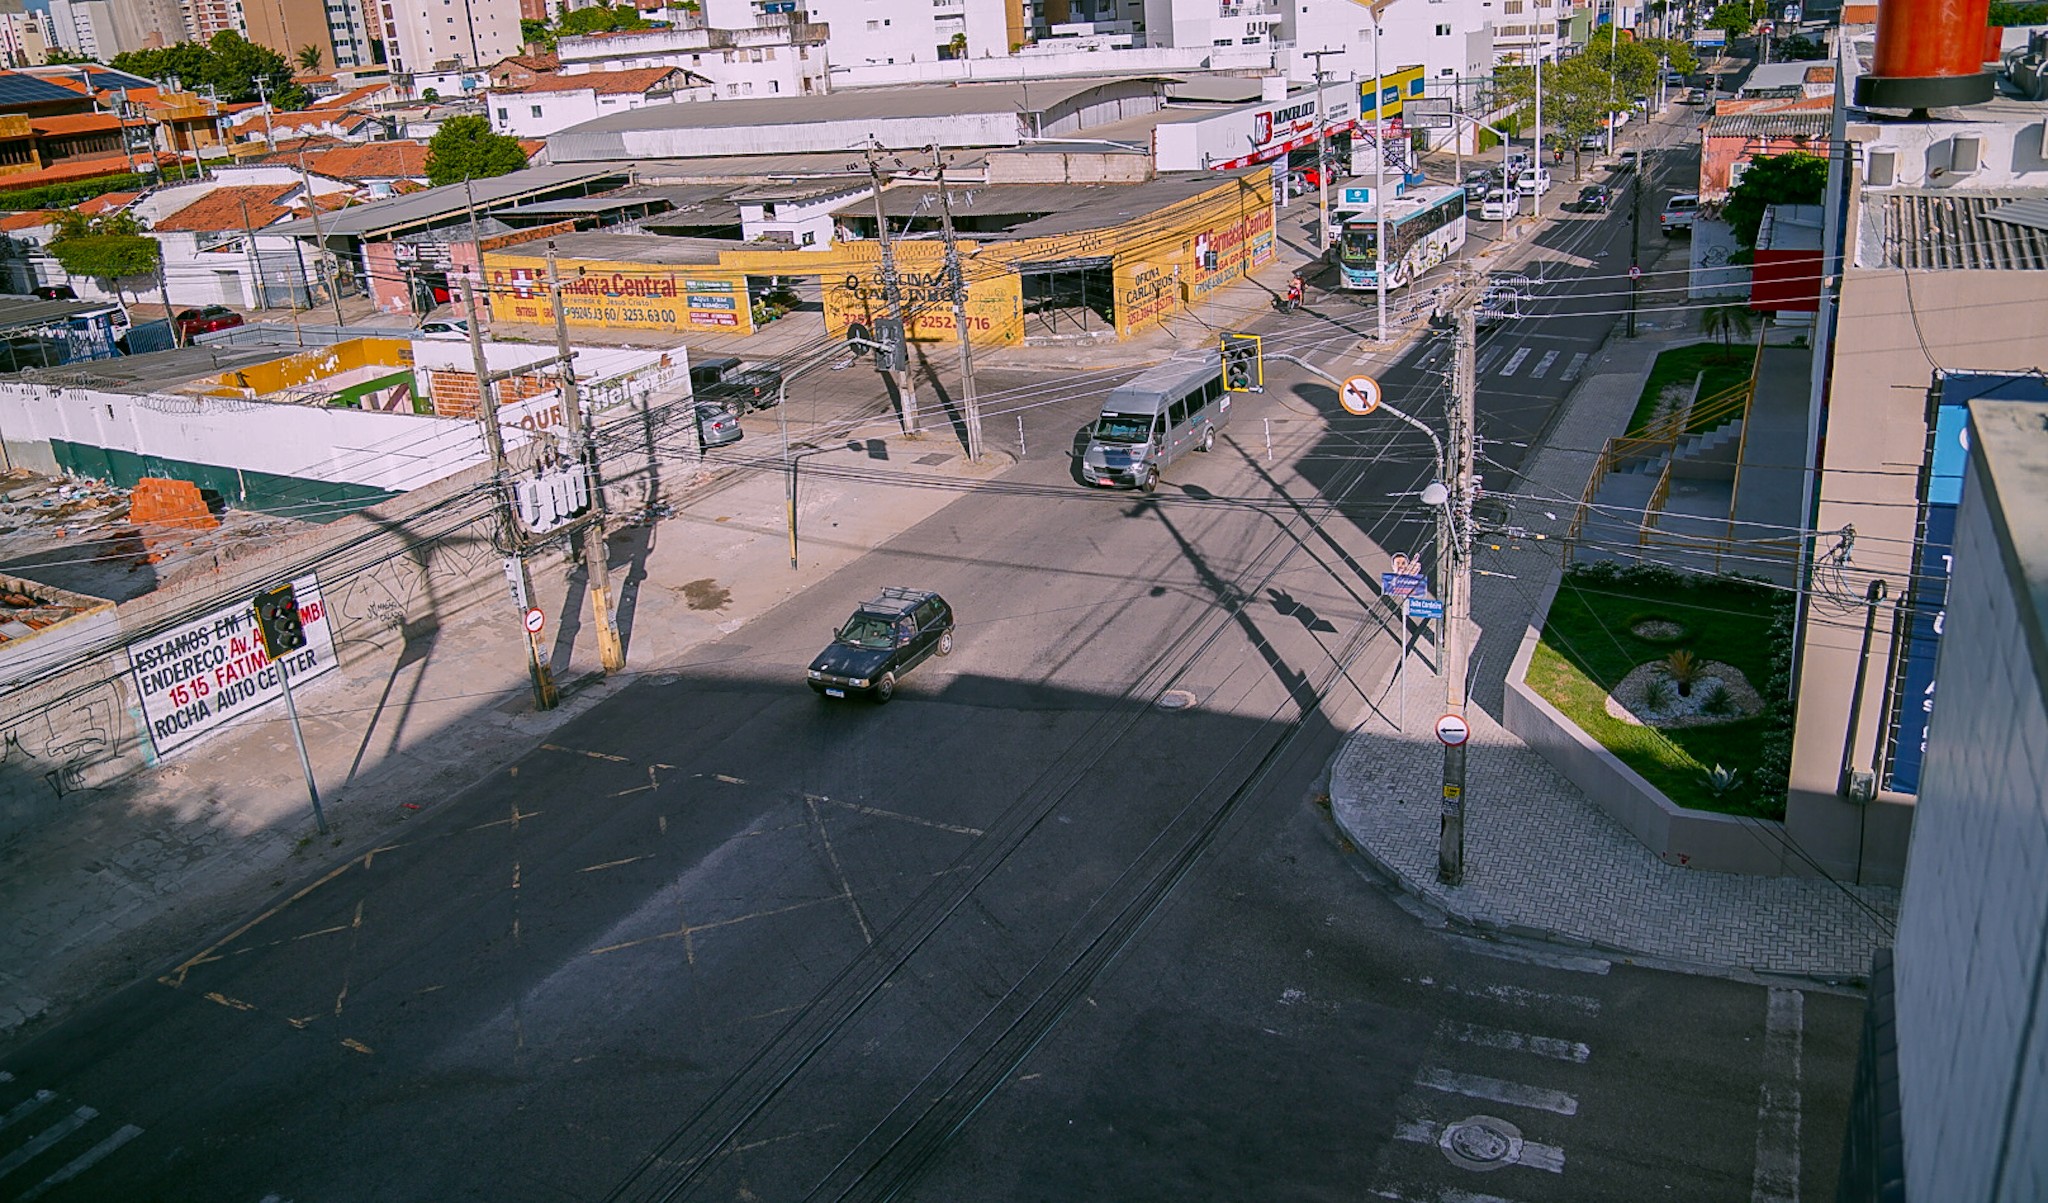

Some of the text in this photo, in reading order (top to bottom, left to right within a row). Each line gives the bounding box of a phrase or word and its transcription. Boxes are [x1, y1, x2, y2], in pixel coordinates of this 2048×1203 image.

[1244, 202, 1272, 239] Central
[612, 273, 677, 297] Central
[134, 626, 210, 674] ESTAMOS
[214, 613, 241, 641] EM
[140, 644, 229, 697] ENDEREÇO:
[229, 636, 252, 659] Av.
[154, 702, 212, 741] ROCHA
[217, 677, 256, 713] AUTO
